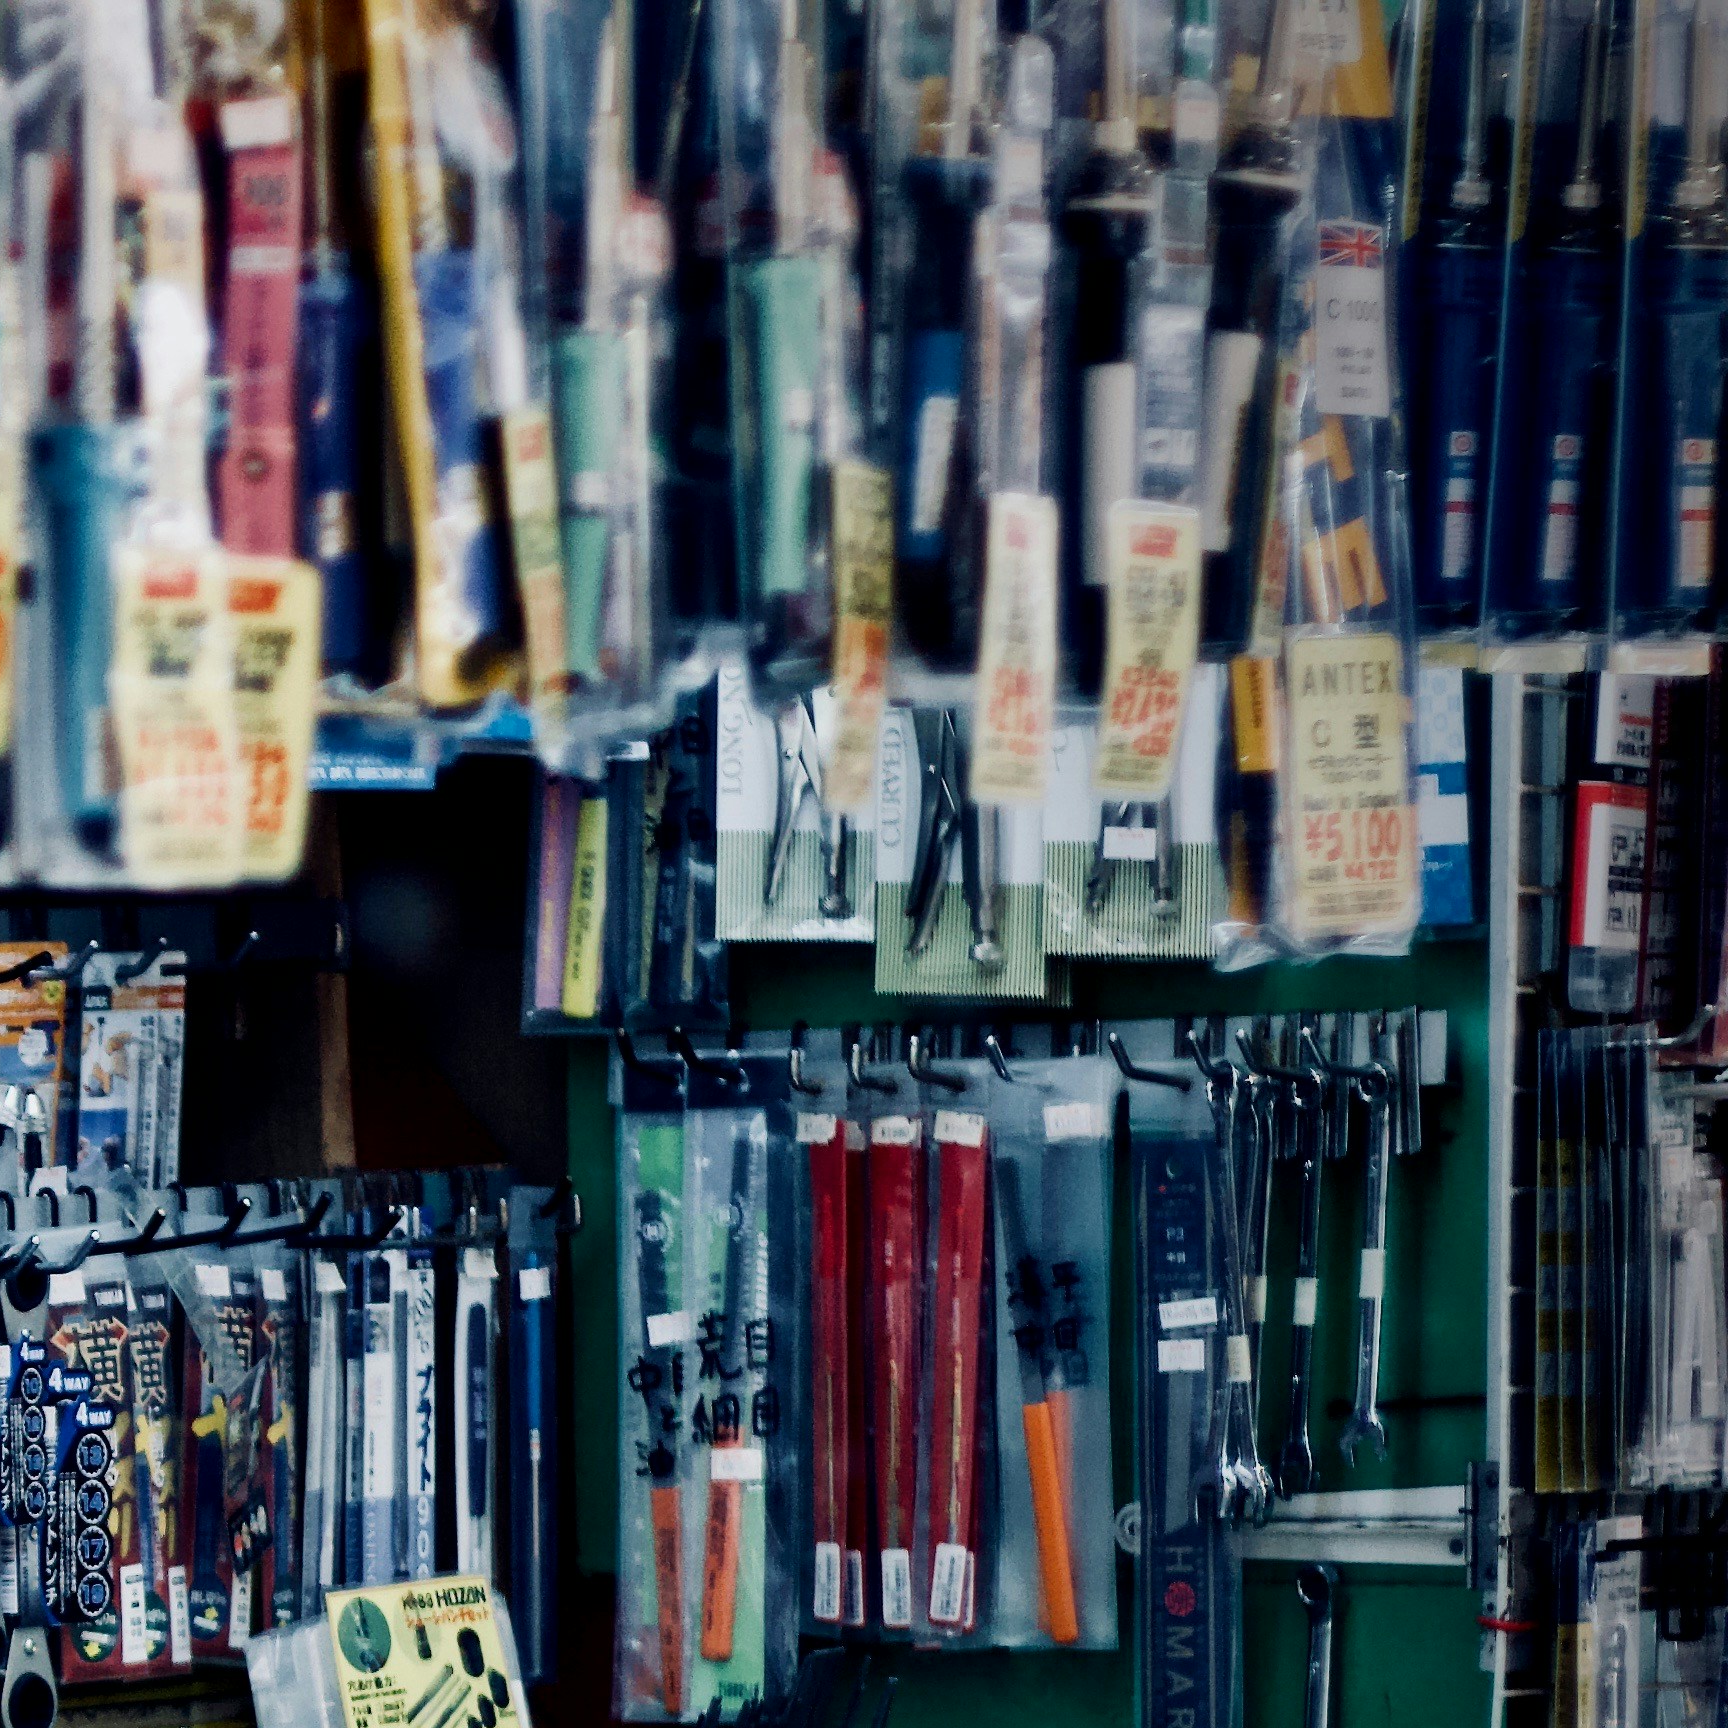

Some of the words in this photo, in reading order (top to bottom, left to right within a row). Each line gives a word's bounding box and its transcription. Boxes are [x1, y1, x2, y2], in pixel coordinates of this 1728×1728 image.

[1300, 660, 1394, 698] ANTEX
[722, 732, 743, 796] LONG
[881, 725, 906, 849] CURVED
[48, 1367, 91, 1393] 4WAY
[75, 1402, 112, 1426] 4WAY
[437, 1586, 487, 1607] HOZAN
